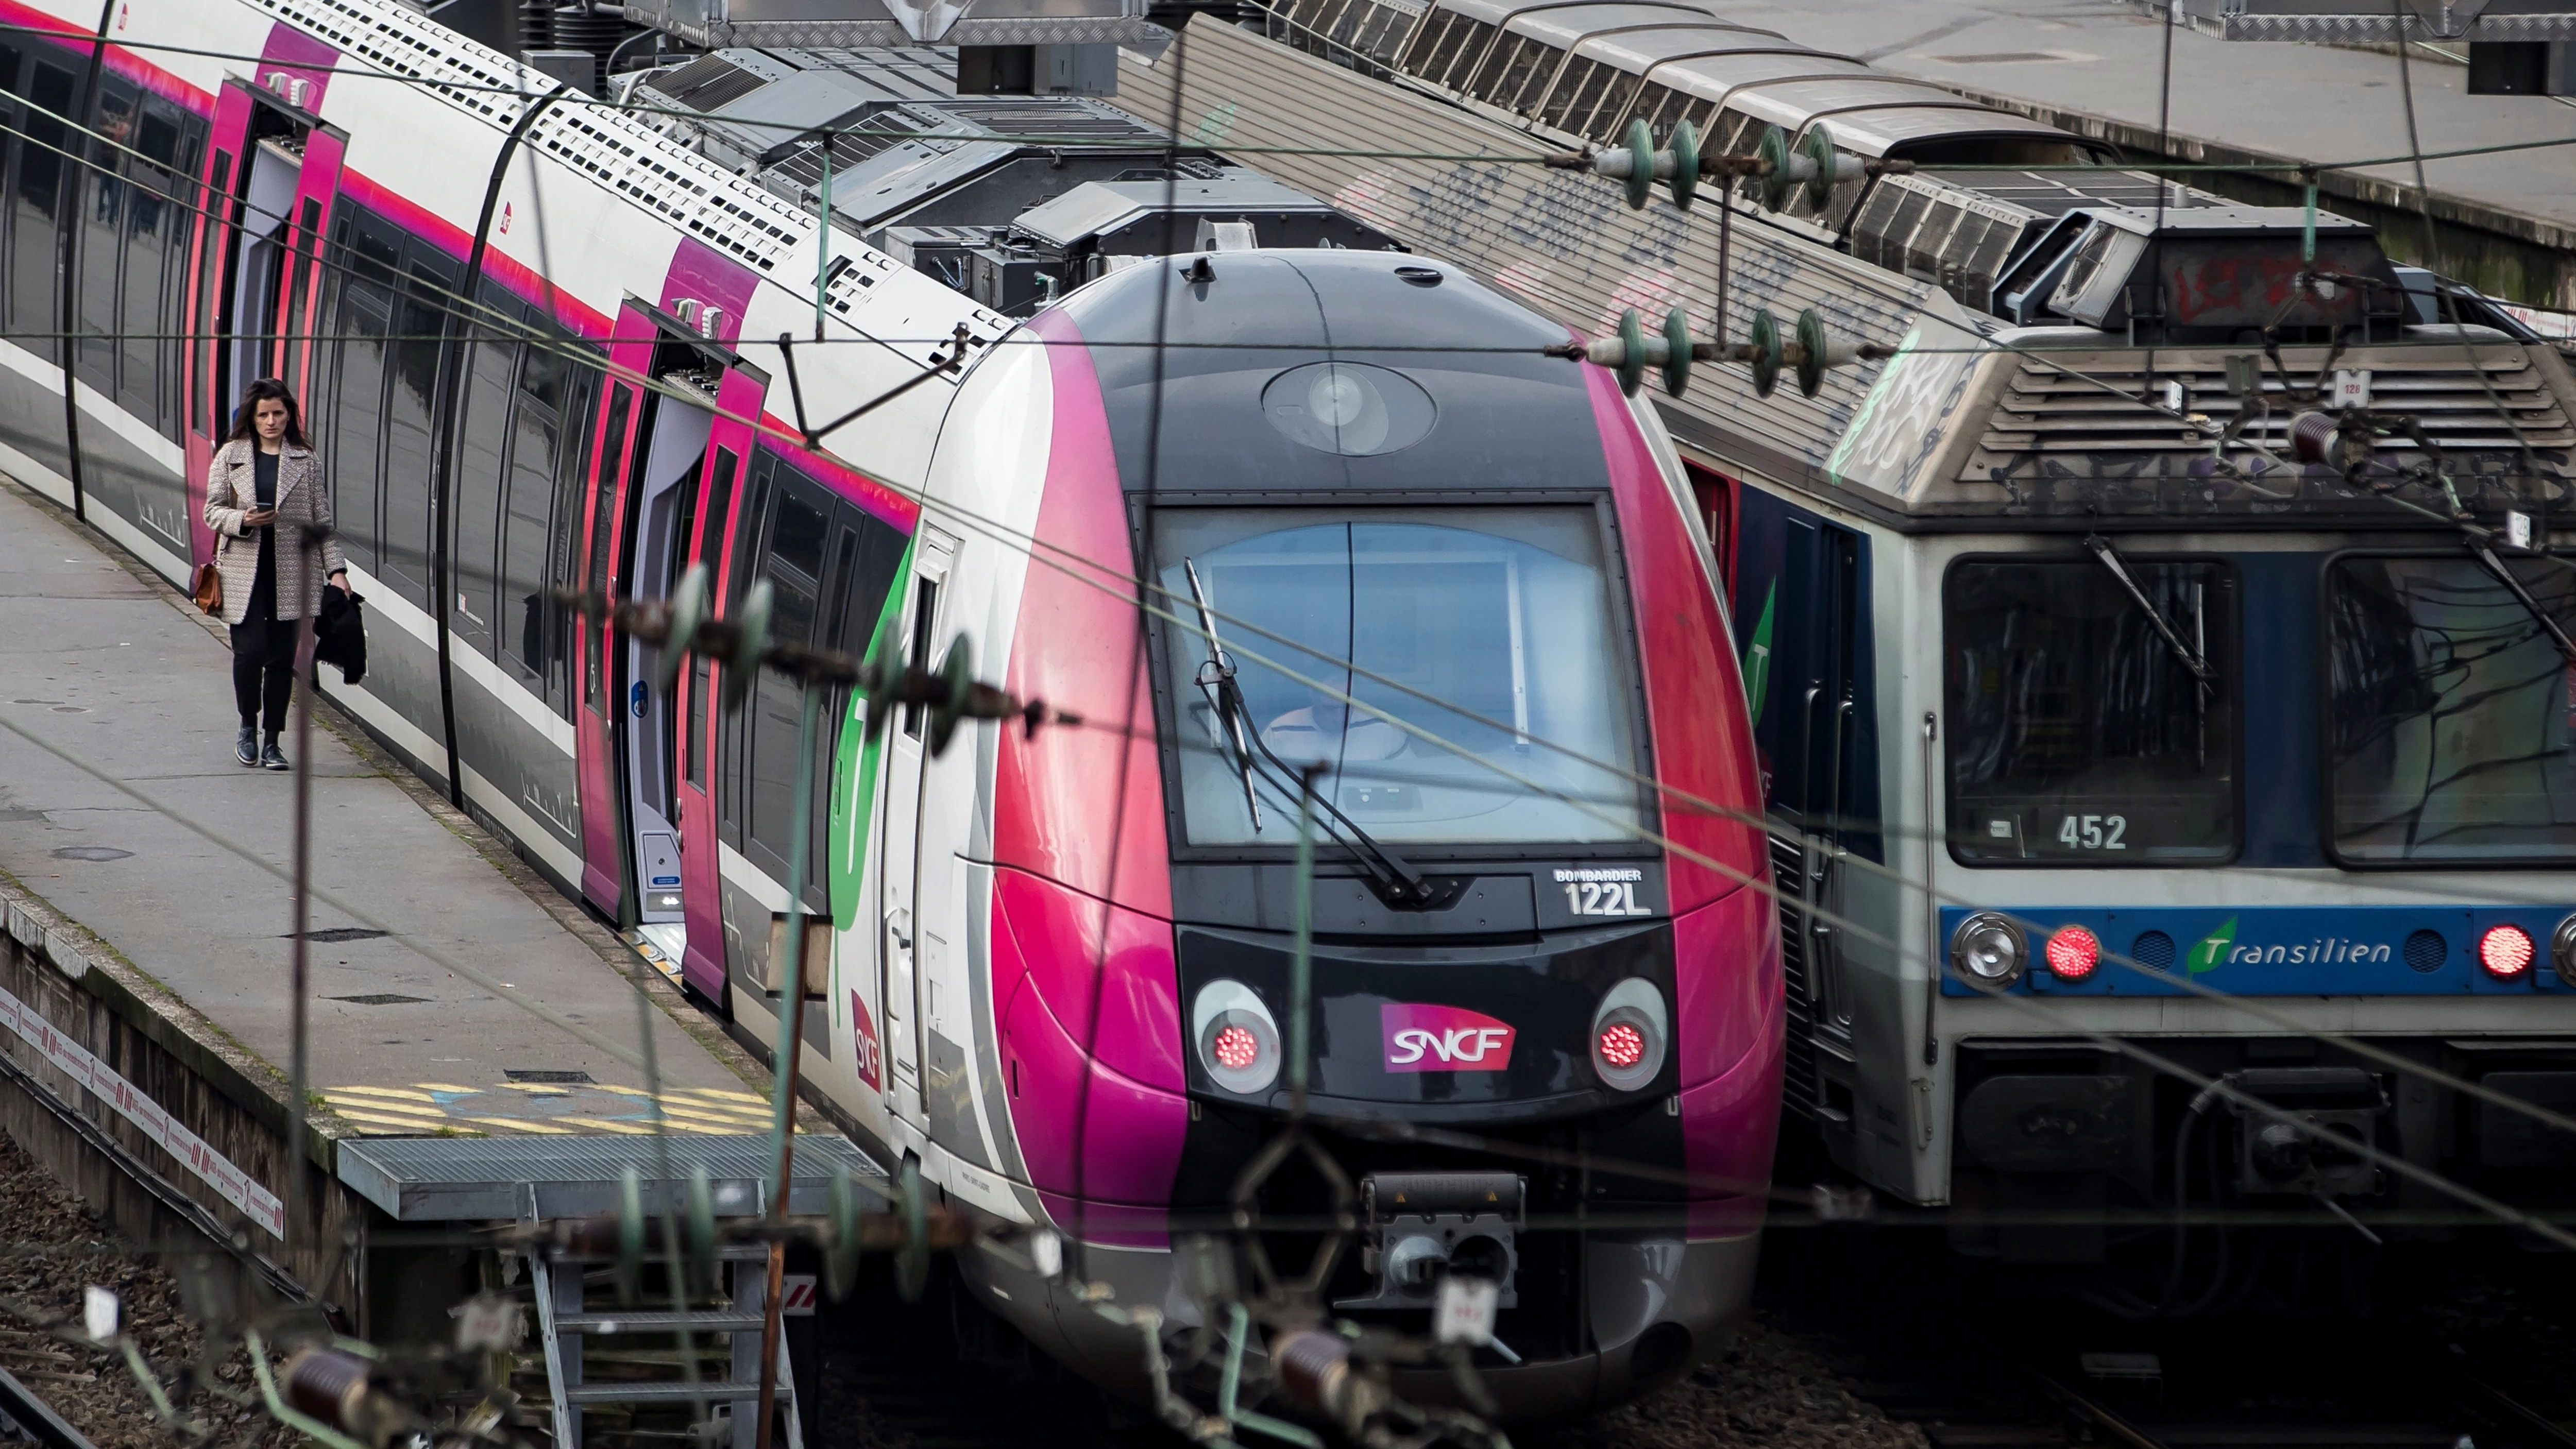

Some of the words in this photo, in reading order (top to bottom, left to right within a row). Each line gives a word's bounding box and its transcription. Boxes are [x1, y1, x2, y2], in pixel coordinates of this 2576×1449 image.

[2345, 384, 2361, 394] 128
[2061, 816, 2126, 849] 452
[1555, 870, 1642, 882] BOMBARDIER
[1566, 882, 1652, 915] 122L
[2205, 938, 2391, 964] Transilien
[856, 1028, 877, 1080] SNCF
[1391, 1029, 1509, 1064] SNCF
